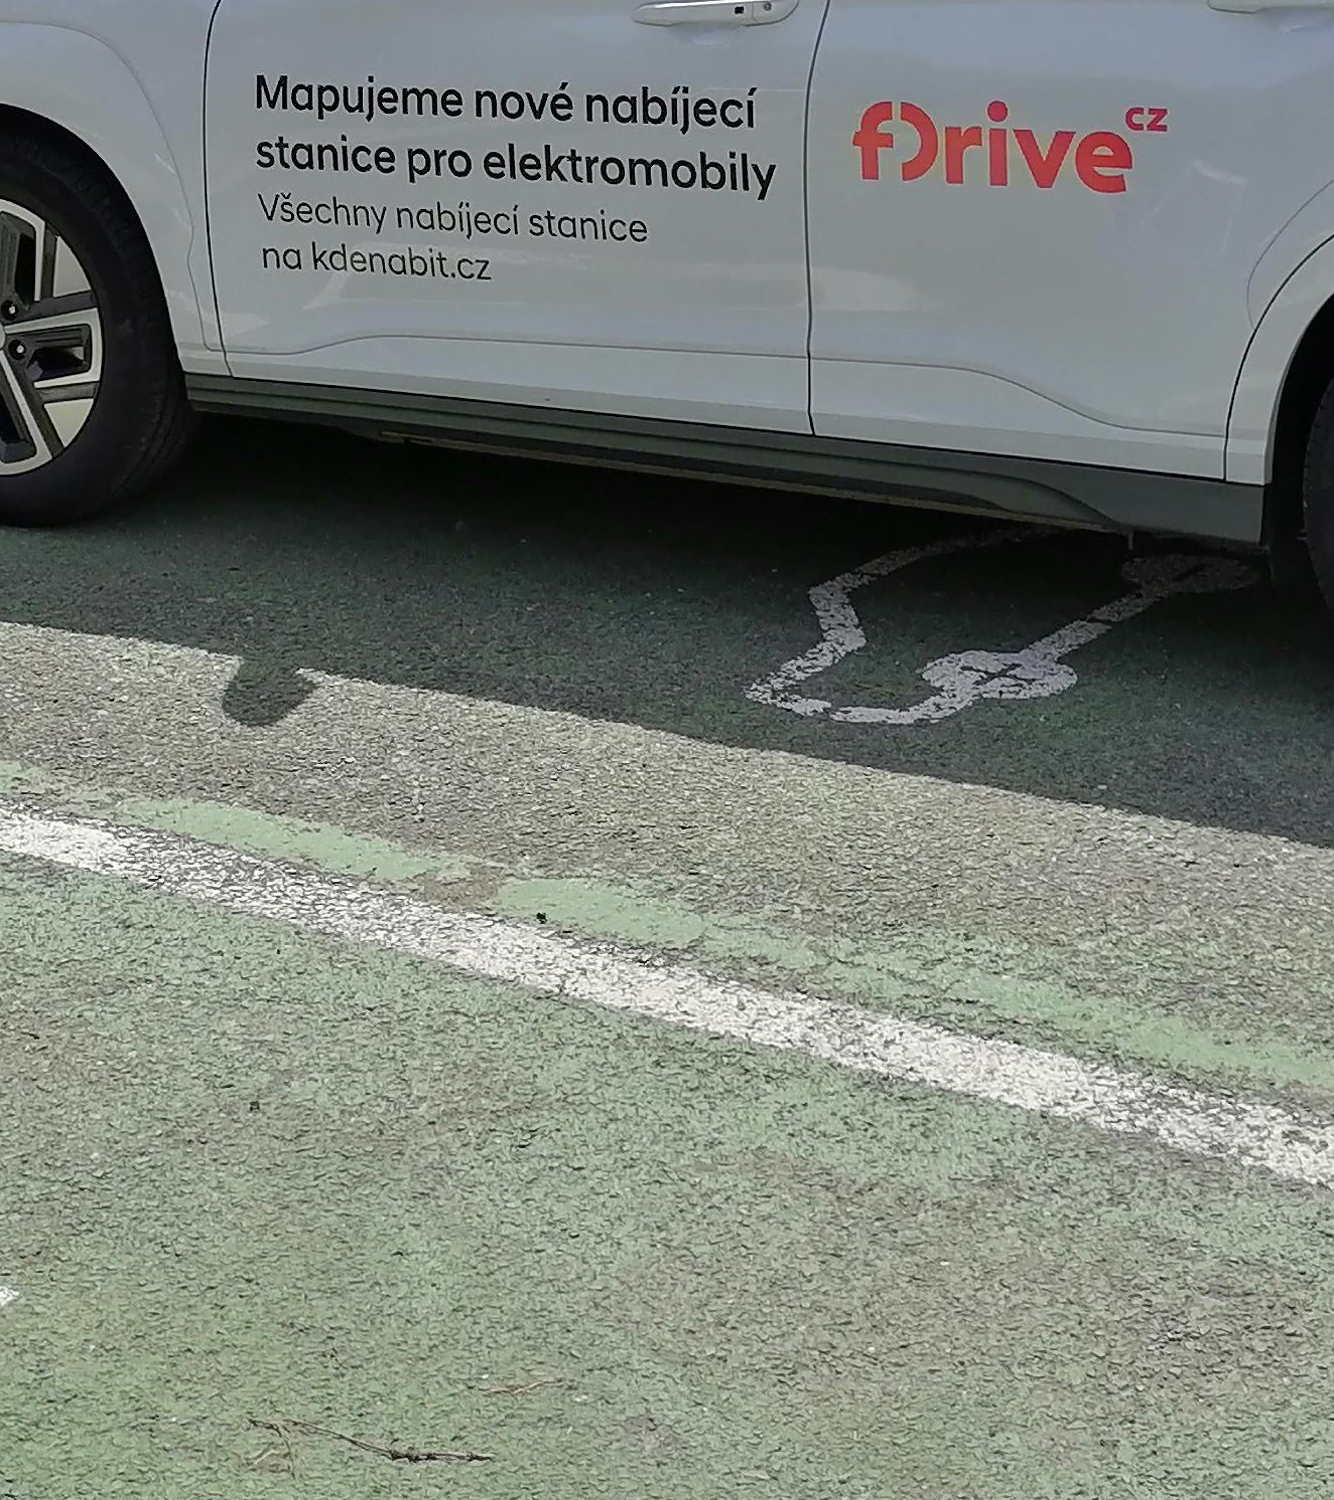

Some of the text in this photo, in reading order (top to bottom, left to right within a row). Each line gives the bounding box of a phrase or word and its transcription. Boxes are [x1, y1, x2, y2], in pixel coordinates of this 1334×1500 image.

[256, 74, 758, 136] Mapujeme nové nabíjecí
[255, 134, 778, 201] stanice pro elektromobily
[257, 192, 649, 243] Všechny nabíjecí stanice
[262, 240, 493, 281] na kdenabit.cz
